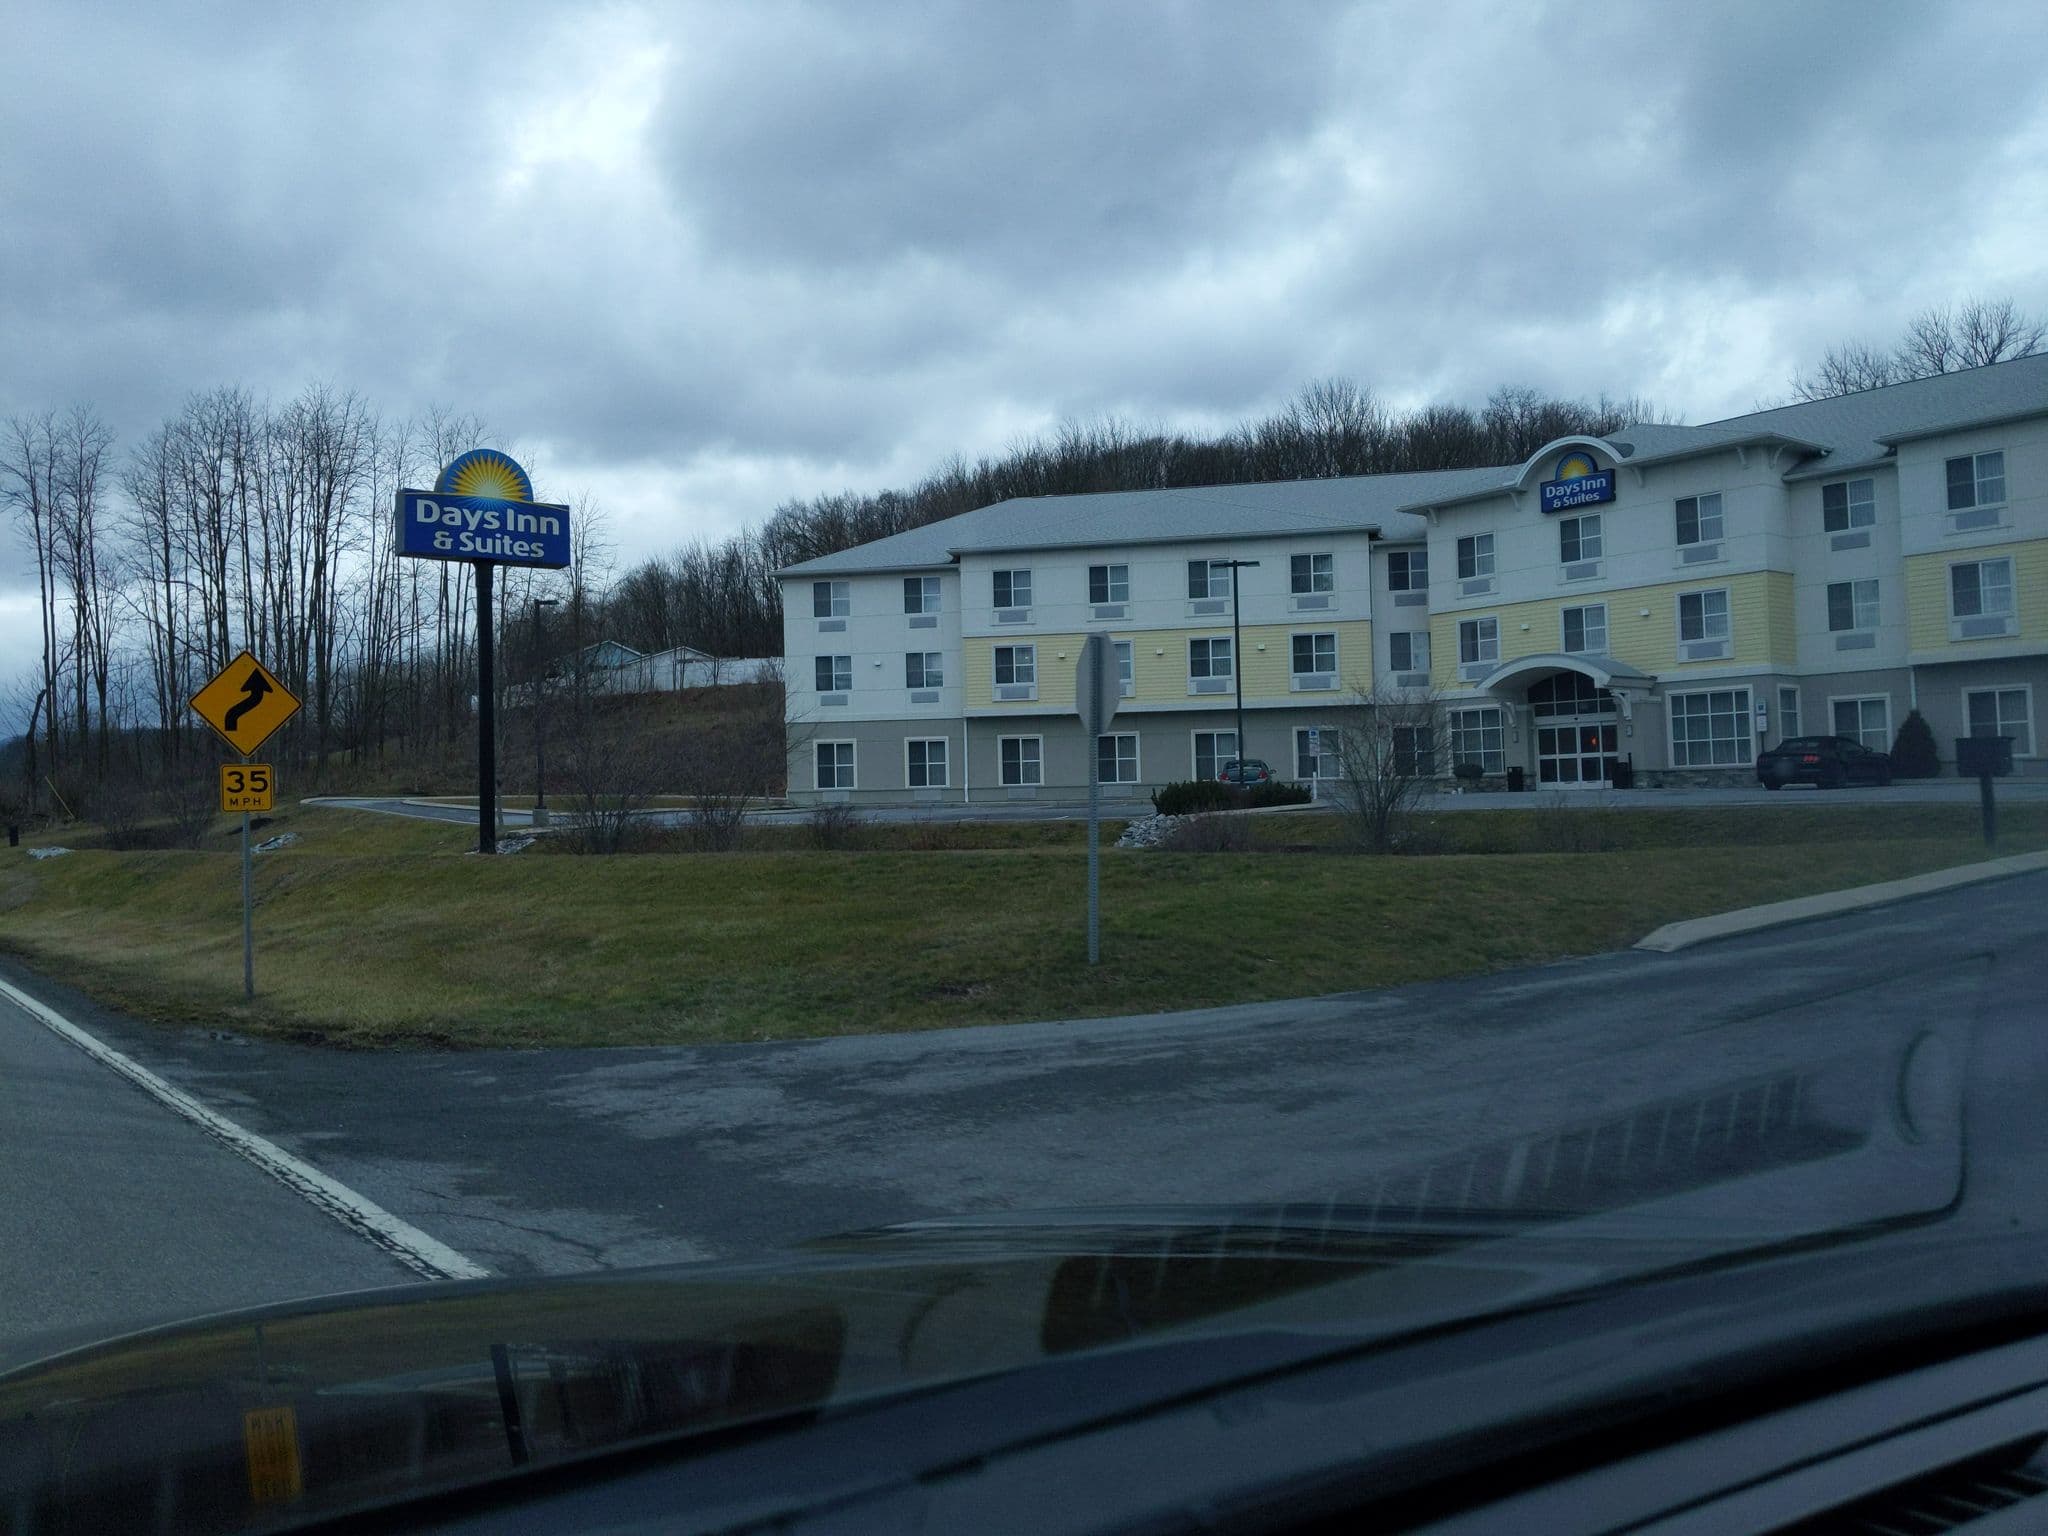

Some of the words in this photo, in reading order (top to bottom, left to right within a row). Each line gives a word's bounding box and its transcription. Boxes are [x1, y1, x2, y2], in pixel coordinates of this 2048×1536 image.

[1545, 482, 1580, 498] Days
[1582, 477, 1607, 491] Inn
[1552, 499, 1561, 508] &
[1563, 492, 1600, 507] Suites
[416, 499, 501, 531] Days
[506, 508, 560, 536] Inn
[433, 530, 453, 550] &
[459, 531, 545, 558] Suites
[226, 770, 269, 793] 35
[230, 797, 262, 806] MPH
